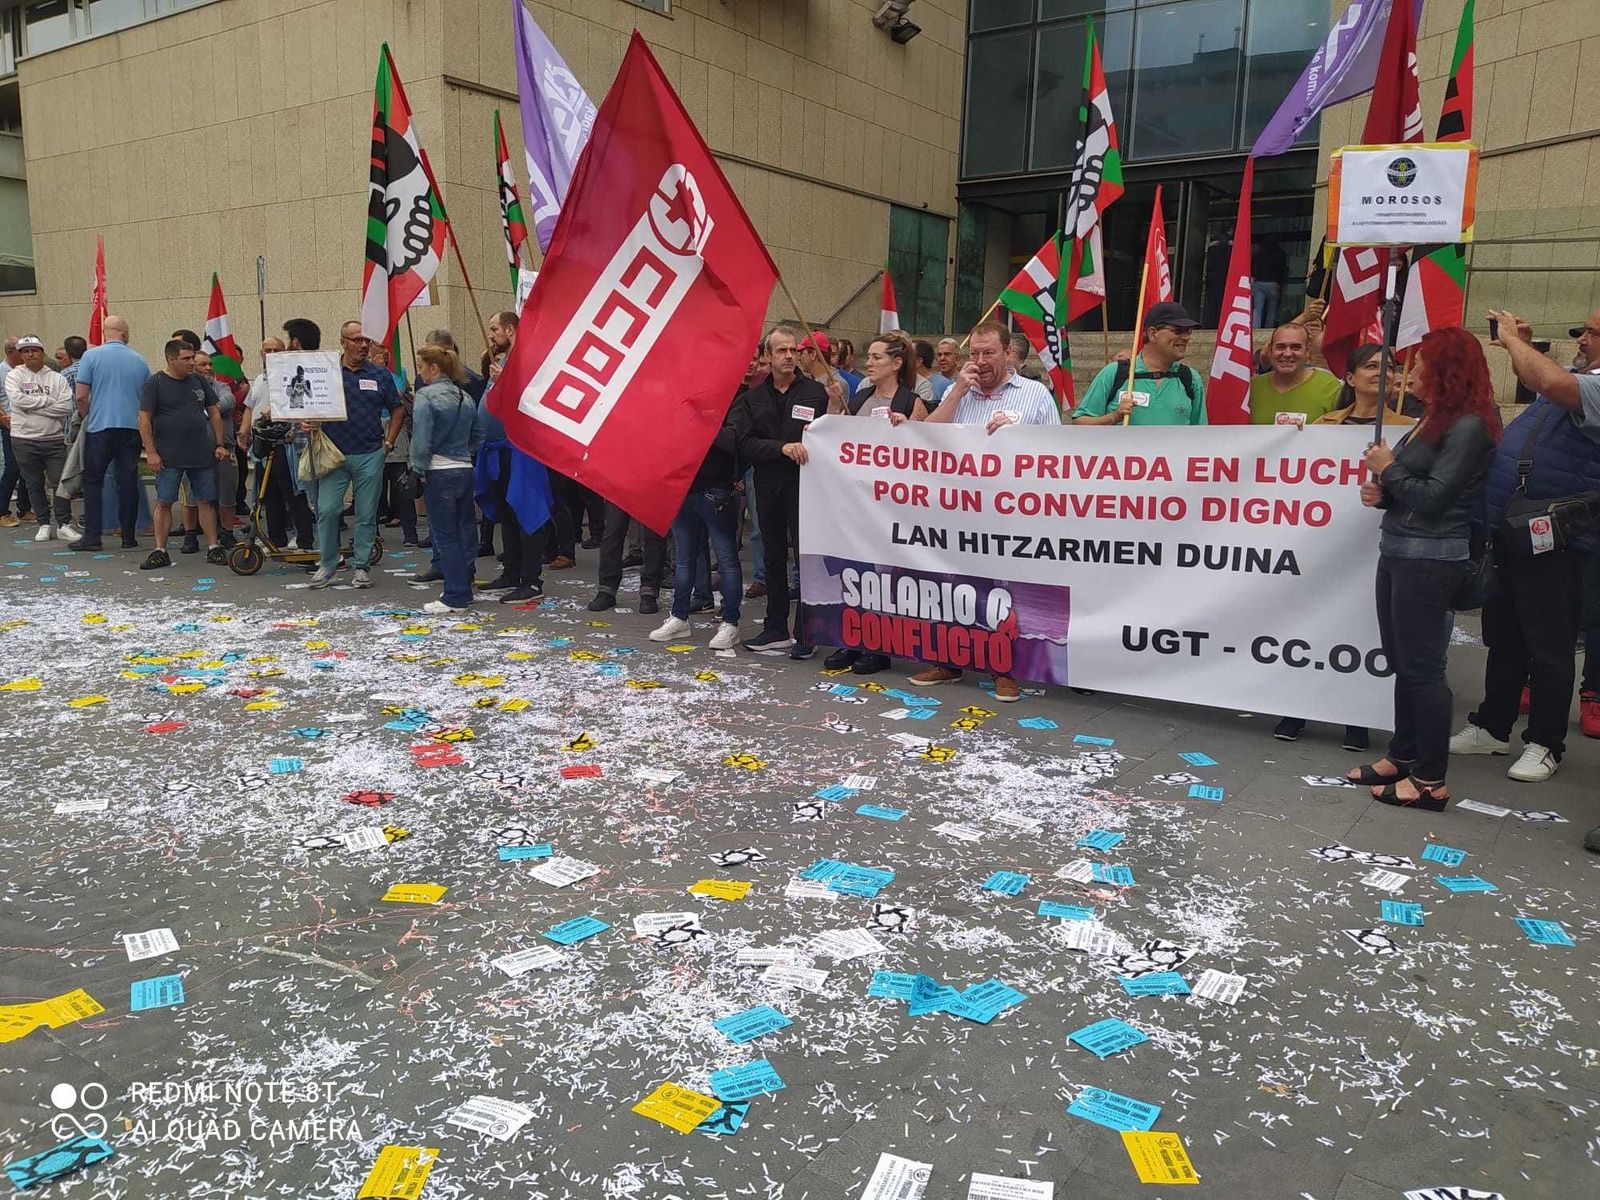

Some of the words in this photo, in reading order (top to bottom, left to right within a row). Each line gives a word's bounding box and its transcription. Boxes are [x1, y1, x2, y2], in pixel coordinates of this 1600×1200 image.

[1361, 195, 1443, 205] MOROSOS
[839, 442, 1002, 477] SEGURIDAD
[1014, 454, 1173, 482] PRIVADA
[1186, 457, 1240, 483] EN
[1254, 457, 1369, 486] LUCH
[874, 480, 930, 508] POR
[939, 487, 982, 513] UN
[994, 491, 1187, 521] CONVENIO
[1201, 497, 1333, 527] DIGNO
[892, 522, 948, 550] LAN
[958, 530, 1162, 566] HITZARMEN
[1177, 543, 1301, 576] DUINA
[841, 566, 977, 626] SALARIO
[986, 587, 1013, 631] O
[841, 607, 1013, 673] CONFLICTO
[1122, 625, 1209, 657] UGT
